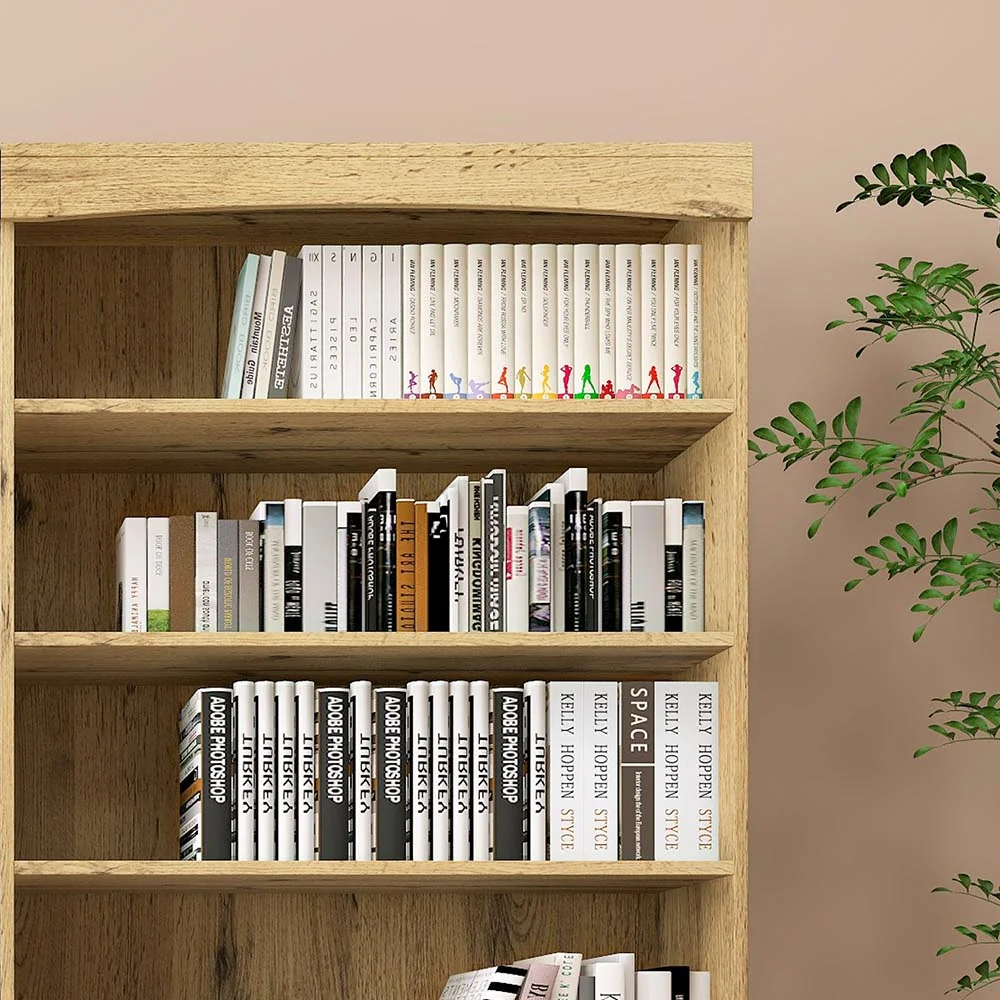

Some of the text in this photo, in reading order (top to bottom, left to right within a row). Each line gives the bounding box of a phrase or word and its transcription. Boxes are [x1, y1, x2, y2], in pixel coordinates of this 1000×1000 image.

[560, 693, 575, 735] KELLY
[630, 688, 648, 753] SPACE
[664, 693, 679, 735] KELLY
[698, 693, 712, 735] KELLY
[210, 696, 226, 804] ADOBE PHOTOSHOP
[327, 696, 344, 804] ADOBE PHOTOSHOP
[502, 696, 518, 804] ADOBE PHOTOSHOP
[560, 744, 575, 799] HOPPEN
[664, 744, 679, 799] HOPPEN
[698, 744, 712, 799] HOPPEN
